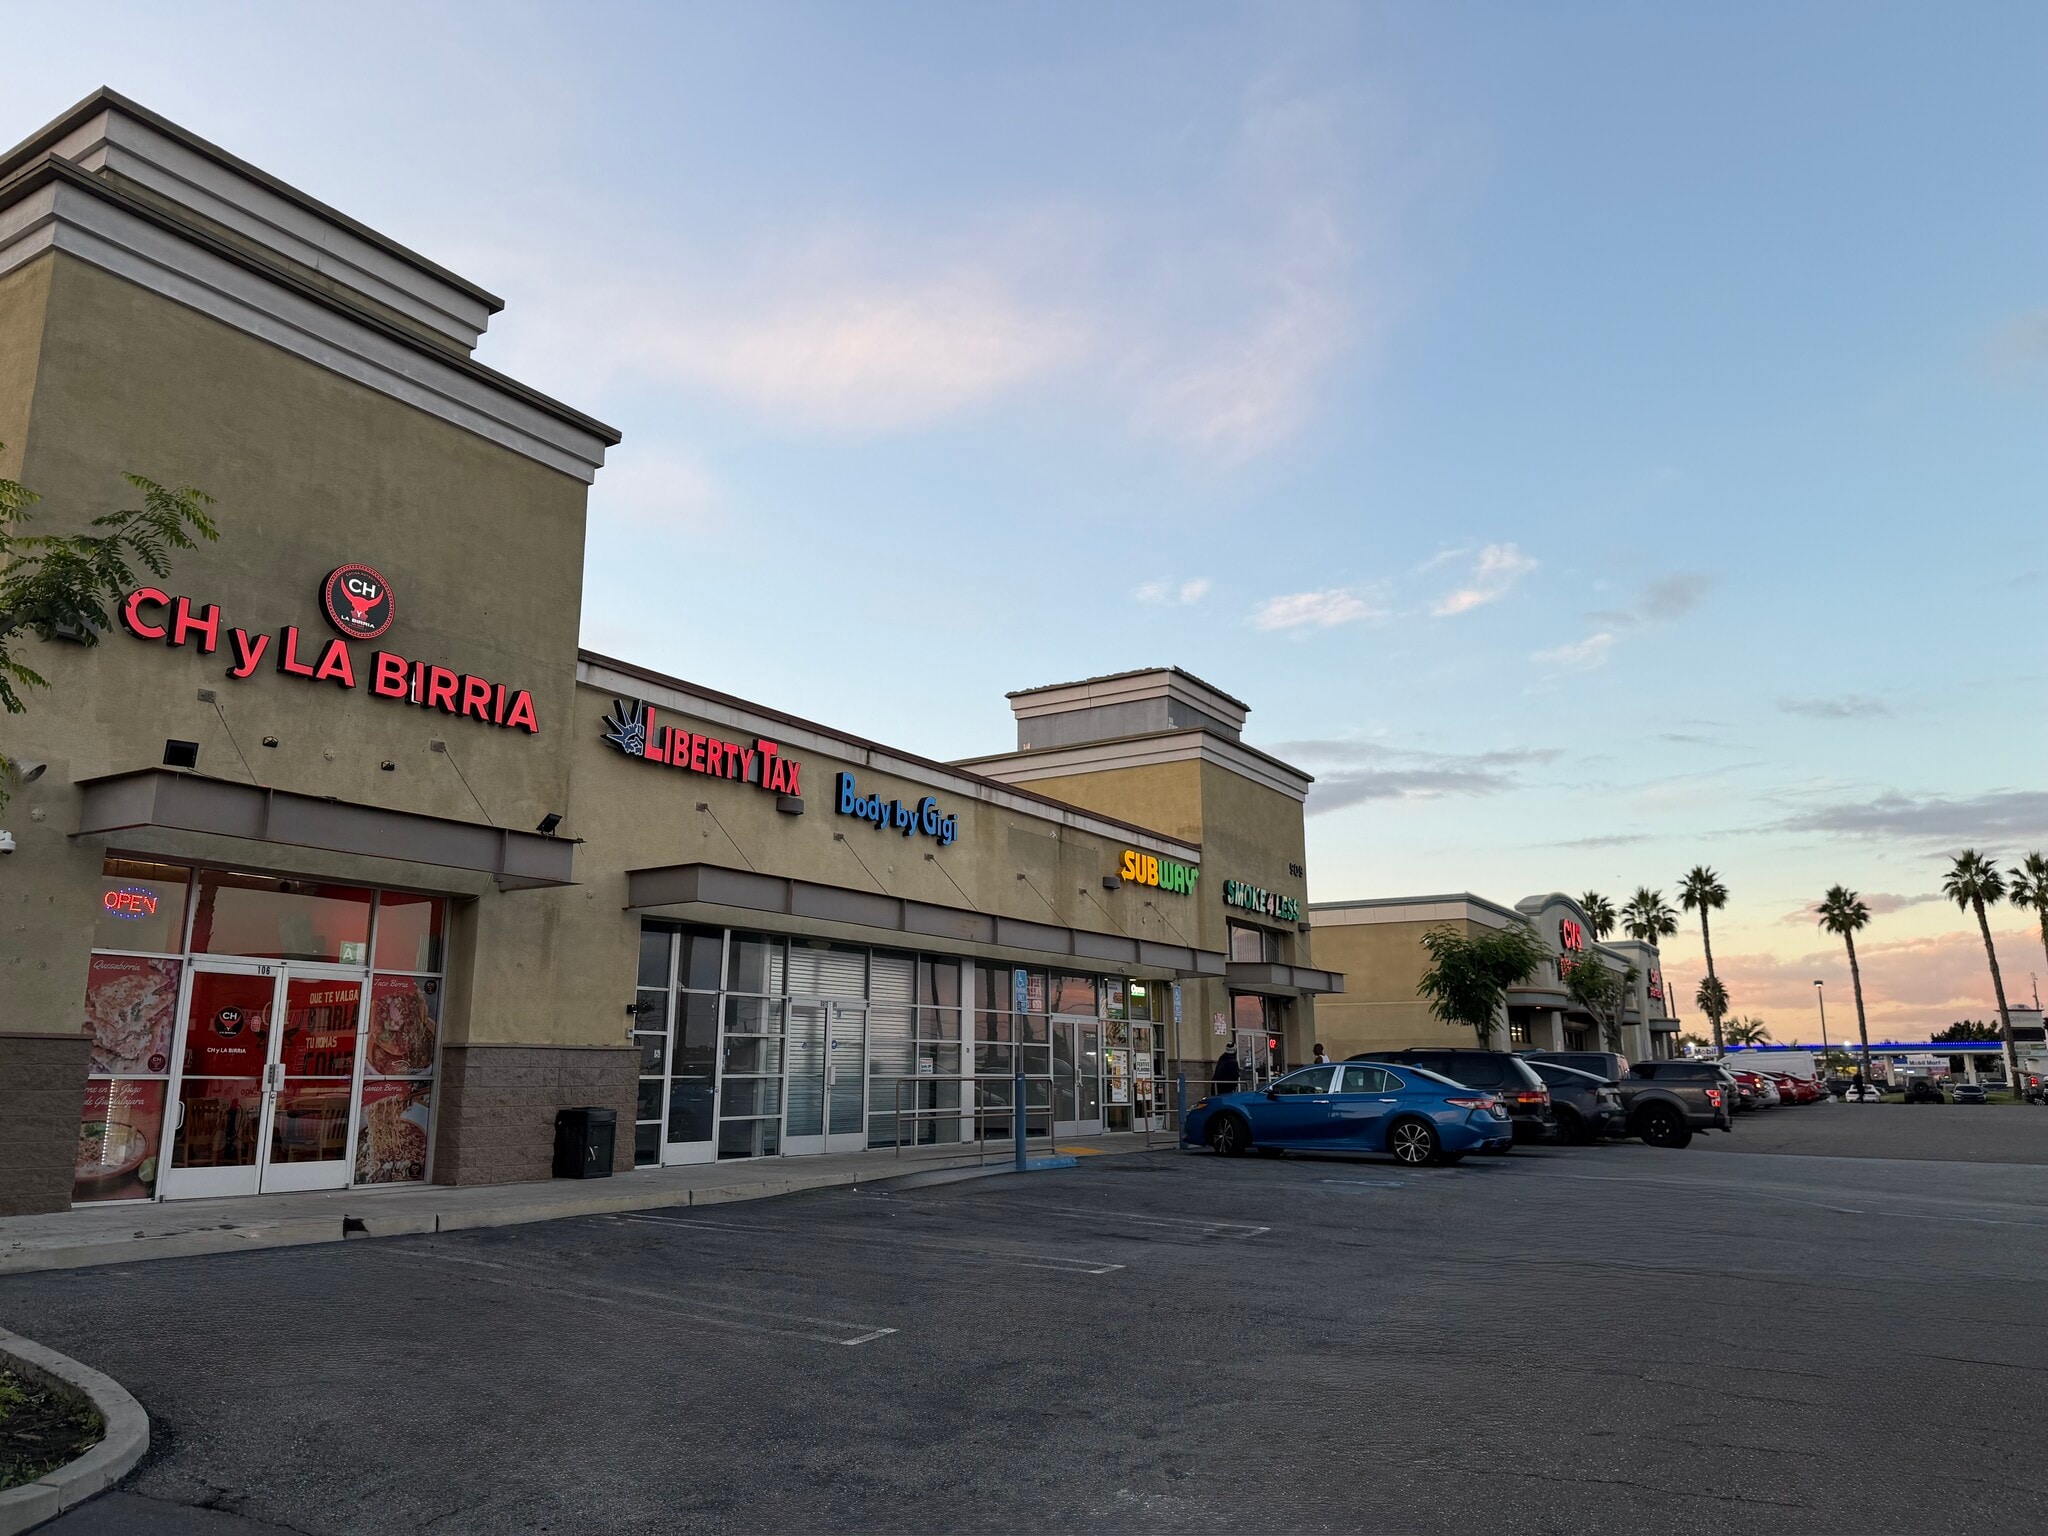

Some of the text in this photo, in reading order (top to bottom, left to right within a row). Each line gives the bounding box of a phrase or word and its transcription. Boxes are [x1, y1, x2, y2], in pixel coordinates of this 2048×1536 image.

[348, 578, 376, 598] CH
[351, 618, 375, 629] BIRRIA
[120, 586, 539, 733] CH y LA BIRRIA
[644, 706, 801, 797] LIBERTY TAX
[835, 771, 958, 846] Body by Gigi
[1121, 850, 1199, 895] SUBWAY
[104, 891, 158, 914] OPEN
[1226, 879, 1300, 920] SMOKE 4 LESS
[1563, 918, 1582, 952] CVS
[343, 947, 353, 960] A
[257, 965, 271, 975] 106
[309, 990, 359, 1004] QUE TE VALGA
[222, 1012, 238, 1020] CH
[306, 1036, 337, 1049] TU NOMAS
